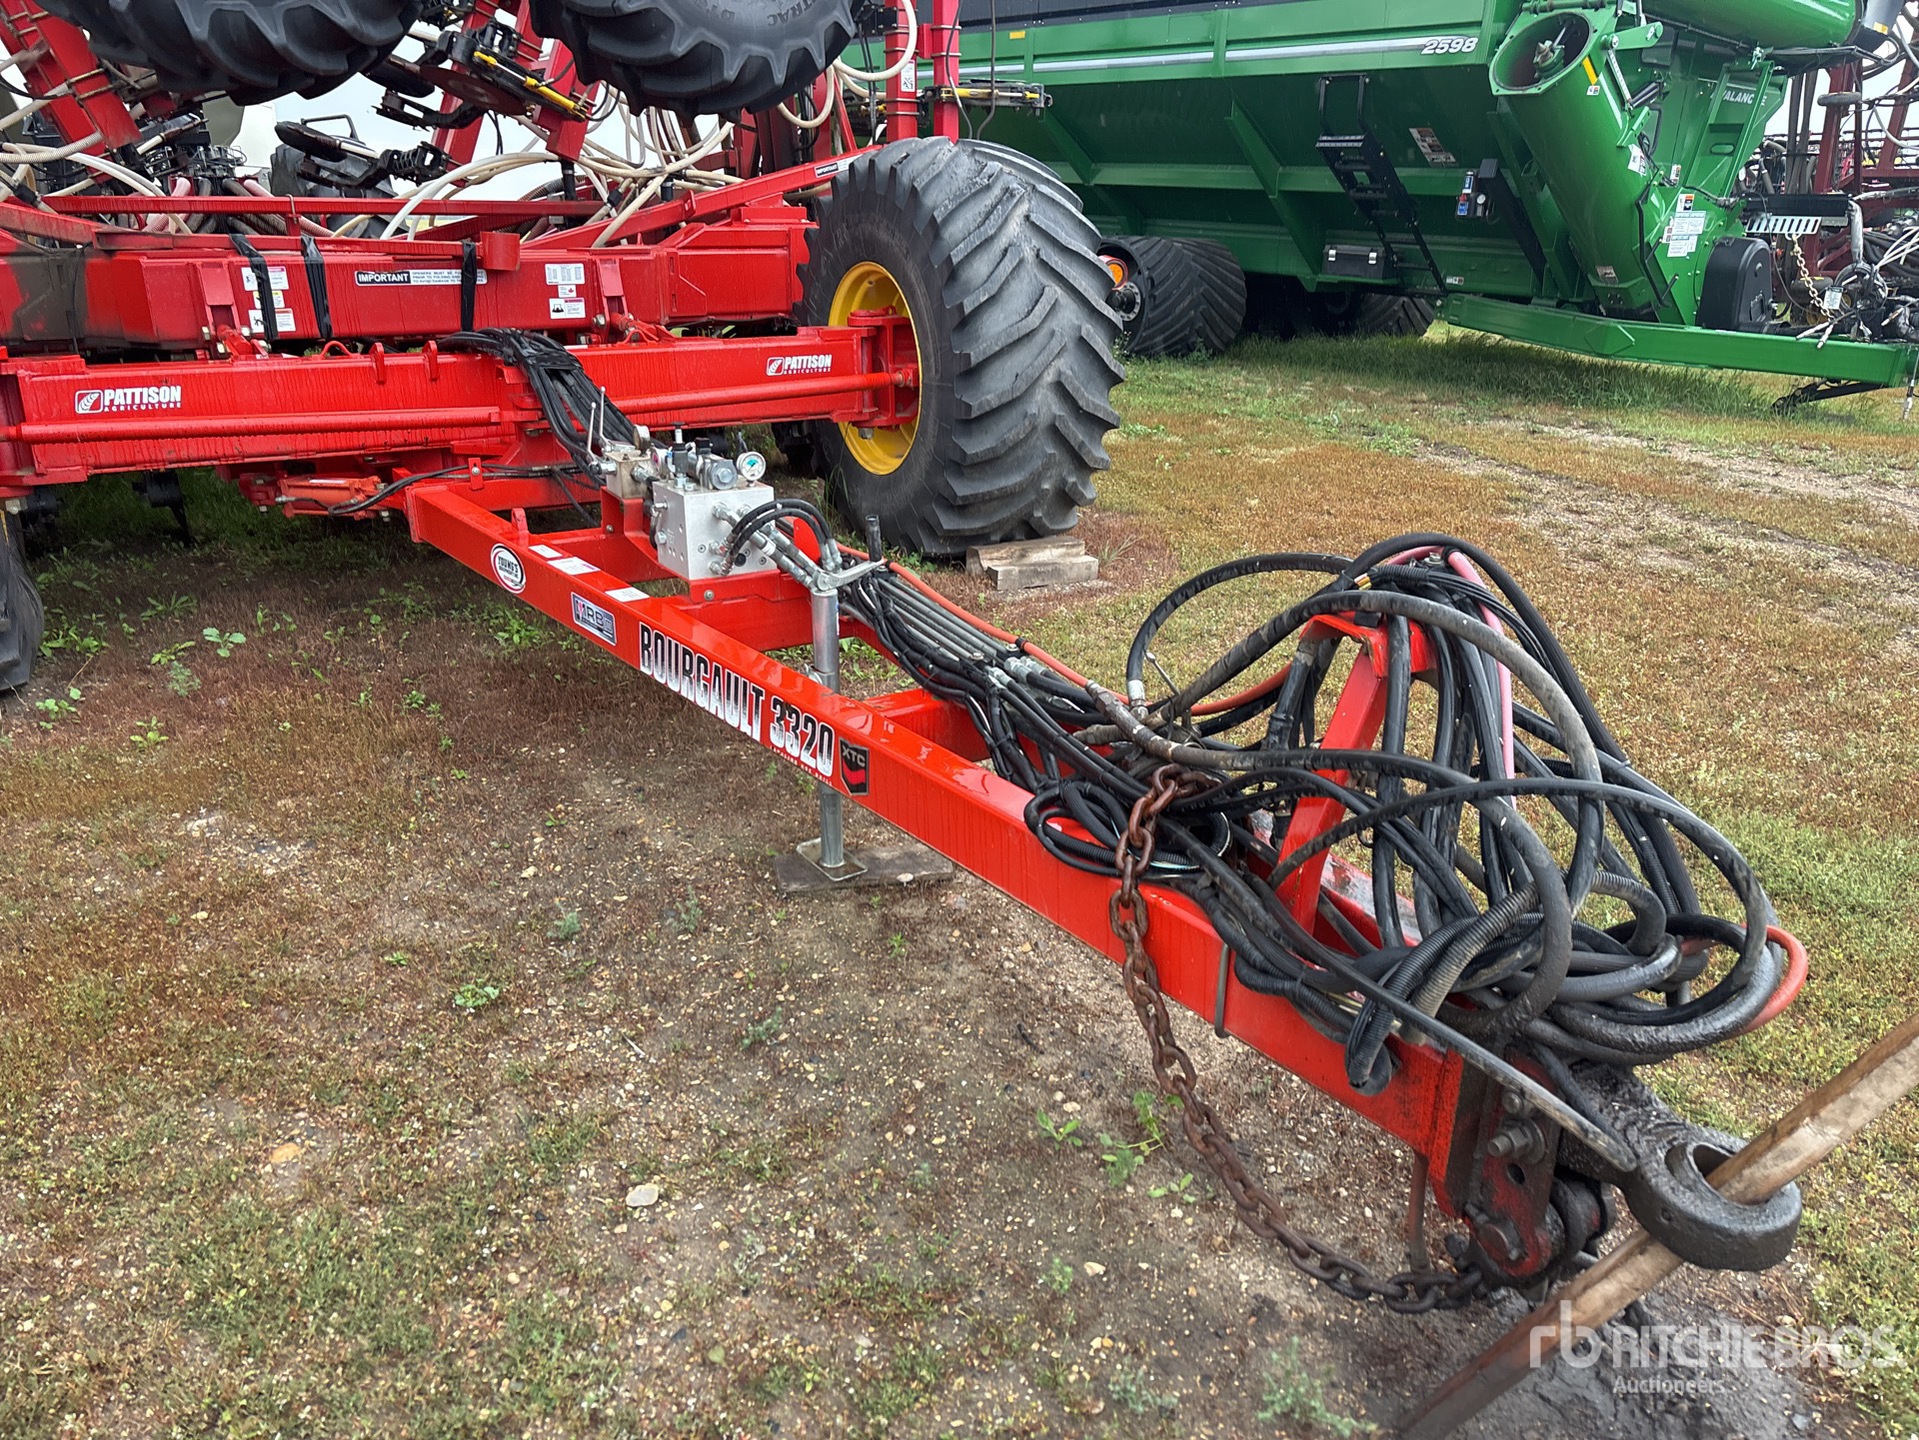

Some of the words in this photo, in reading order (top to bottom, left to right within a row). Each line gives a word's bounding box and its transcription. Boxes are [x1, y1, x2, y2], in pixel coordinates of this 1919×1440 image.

[1421, 37, 1479, 55] 2598
[358, 272, 409, 282] IMPORTANT
[784, 354, 832, 370] PATTISON
[103, 386, 182, 406] PATTISON
[103, 402, 182, 413] AGRICULTURE
[639, 621, 766, 743] BOURGAULT
[769, 695, 835, 778] 3320
[842, 744, 866, 768] XTC
